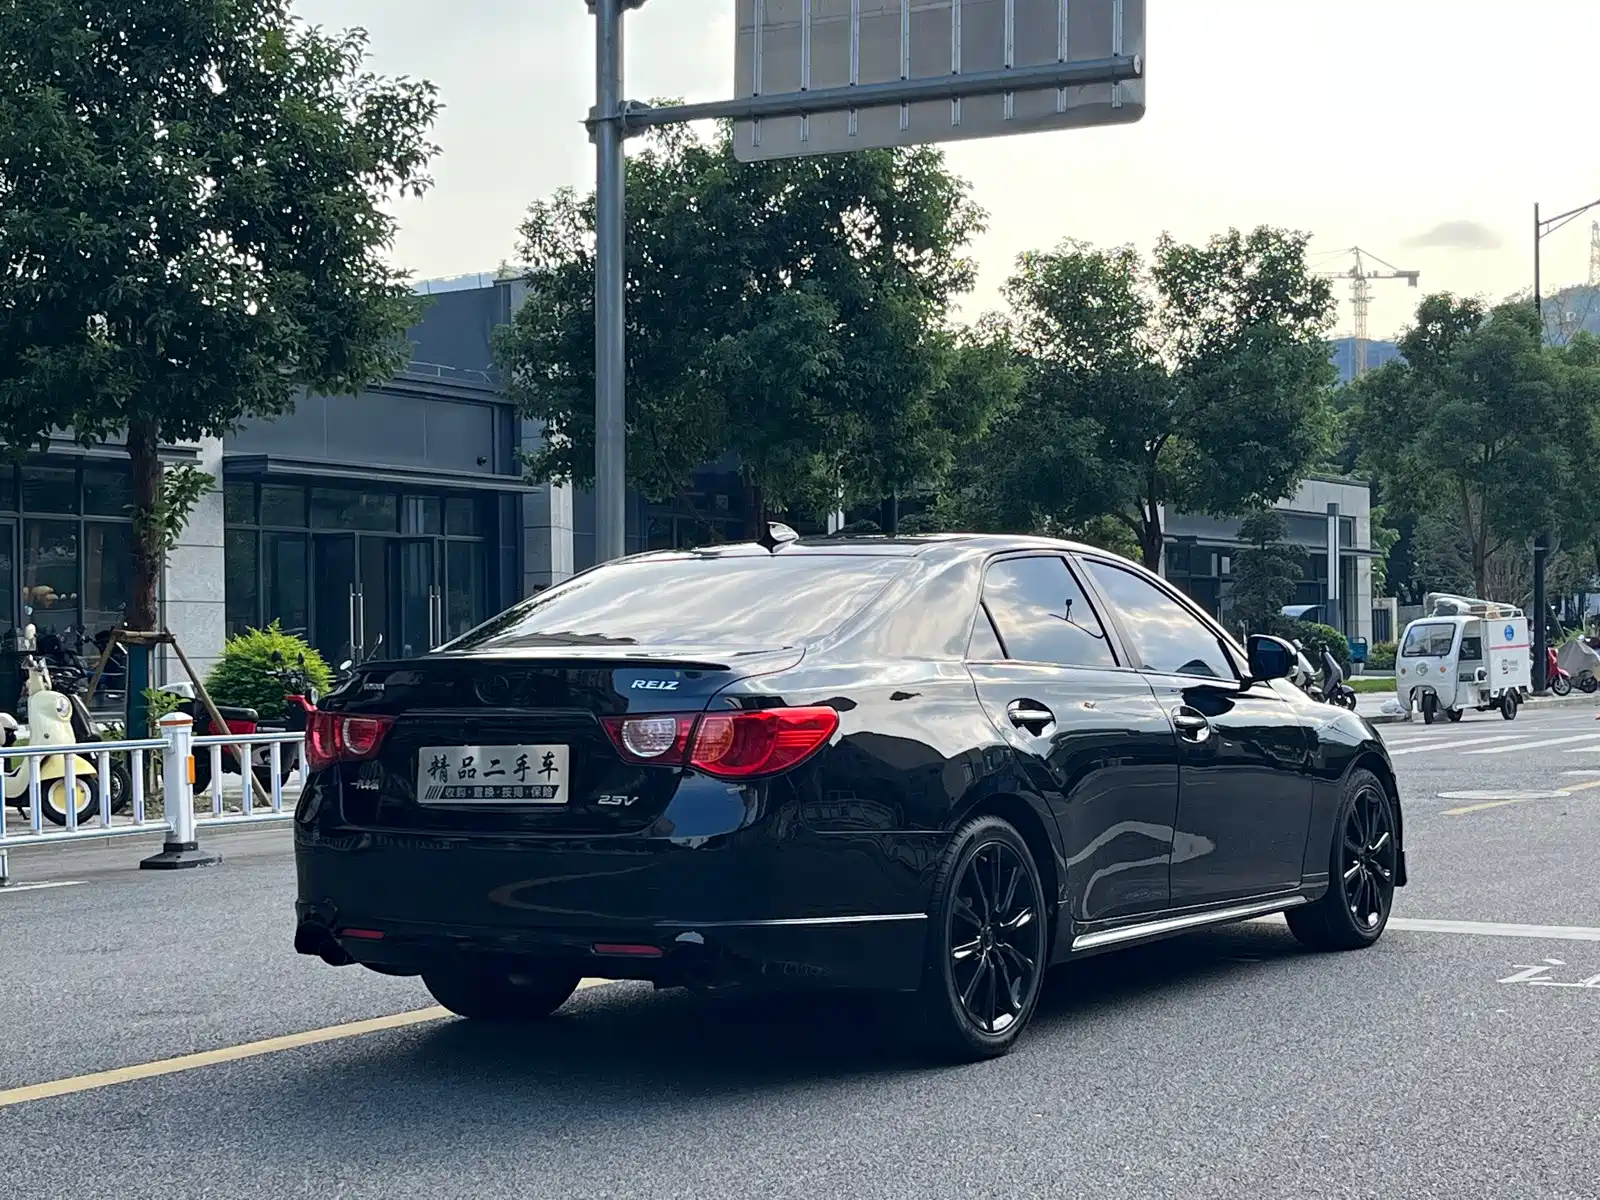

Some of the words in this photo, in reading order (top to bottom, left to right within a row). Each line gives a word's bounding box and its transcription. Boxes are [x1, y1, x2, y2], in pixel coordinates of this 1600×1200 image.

[631, 680, 679, 690] REIZ
[427, 751, 559, 783] 精品二手车
